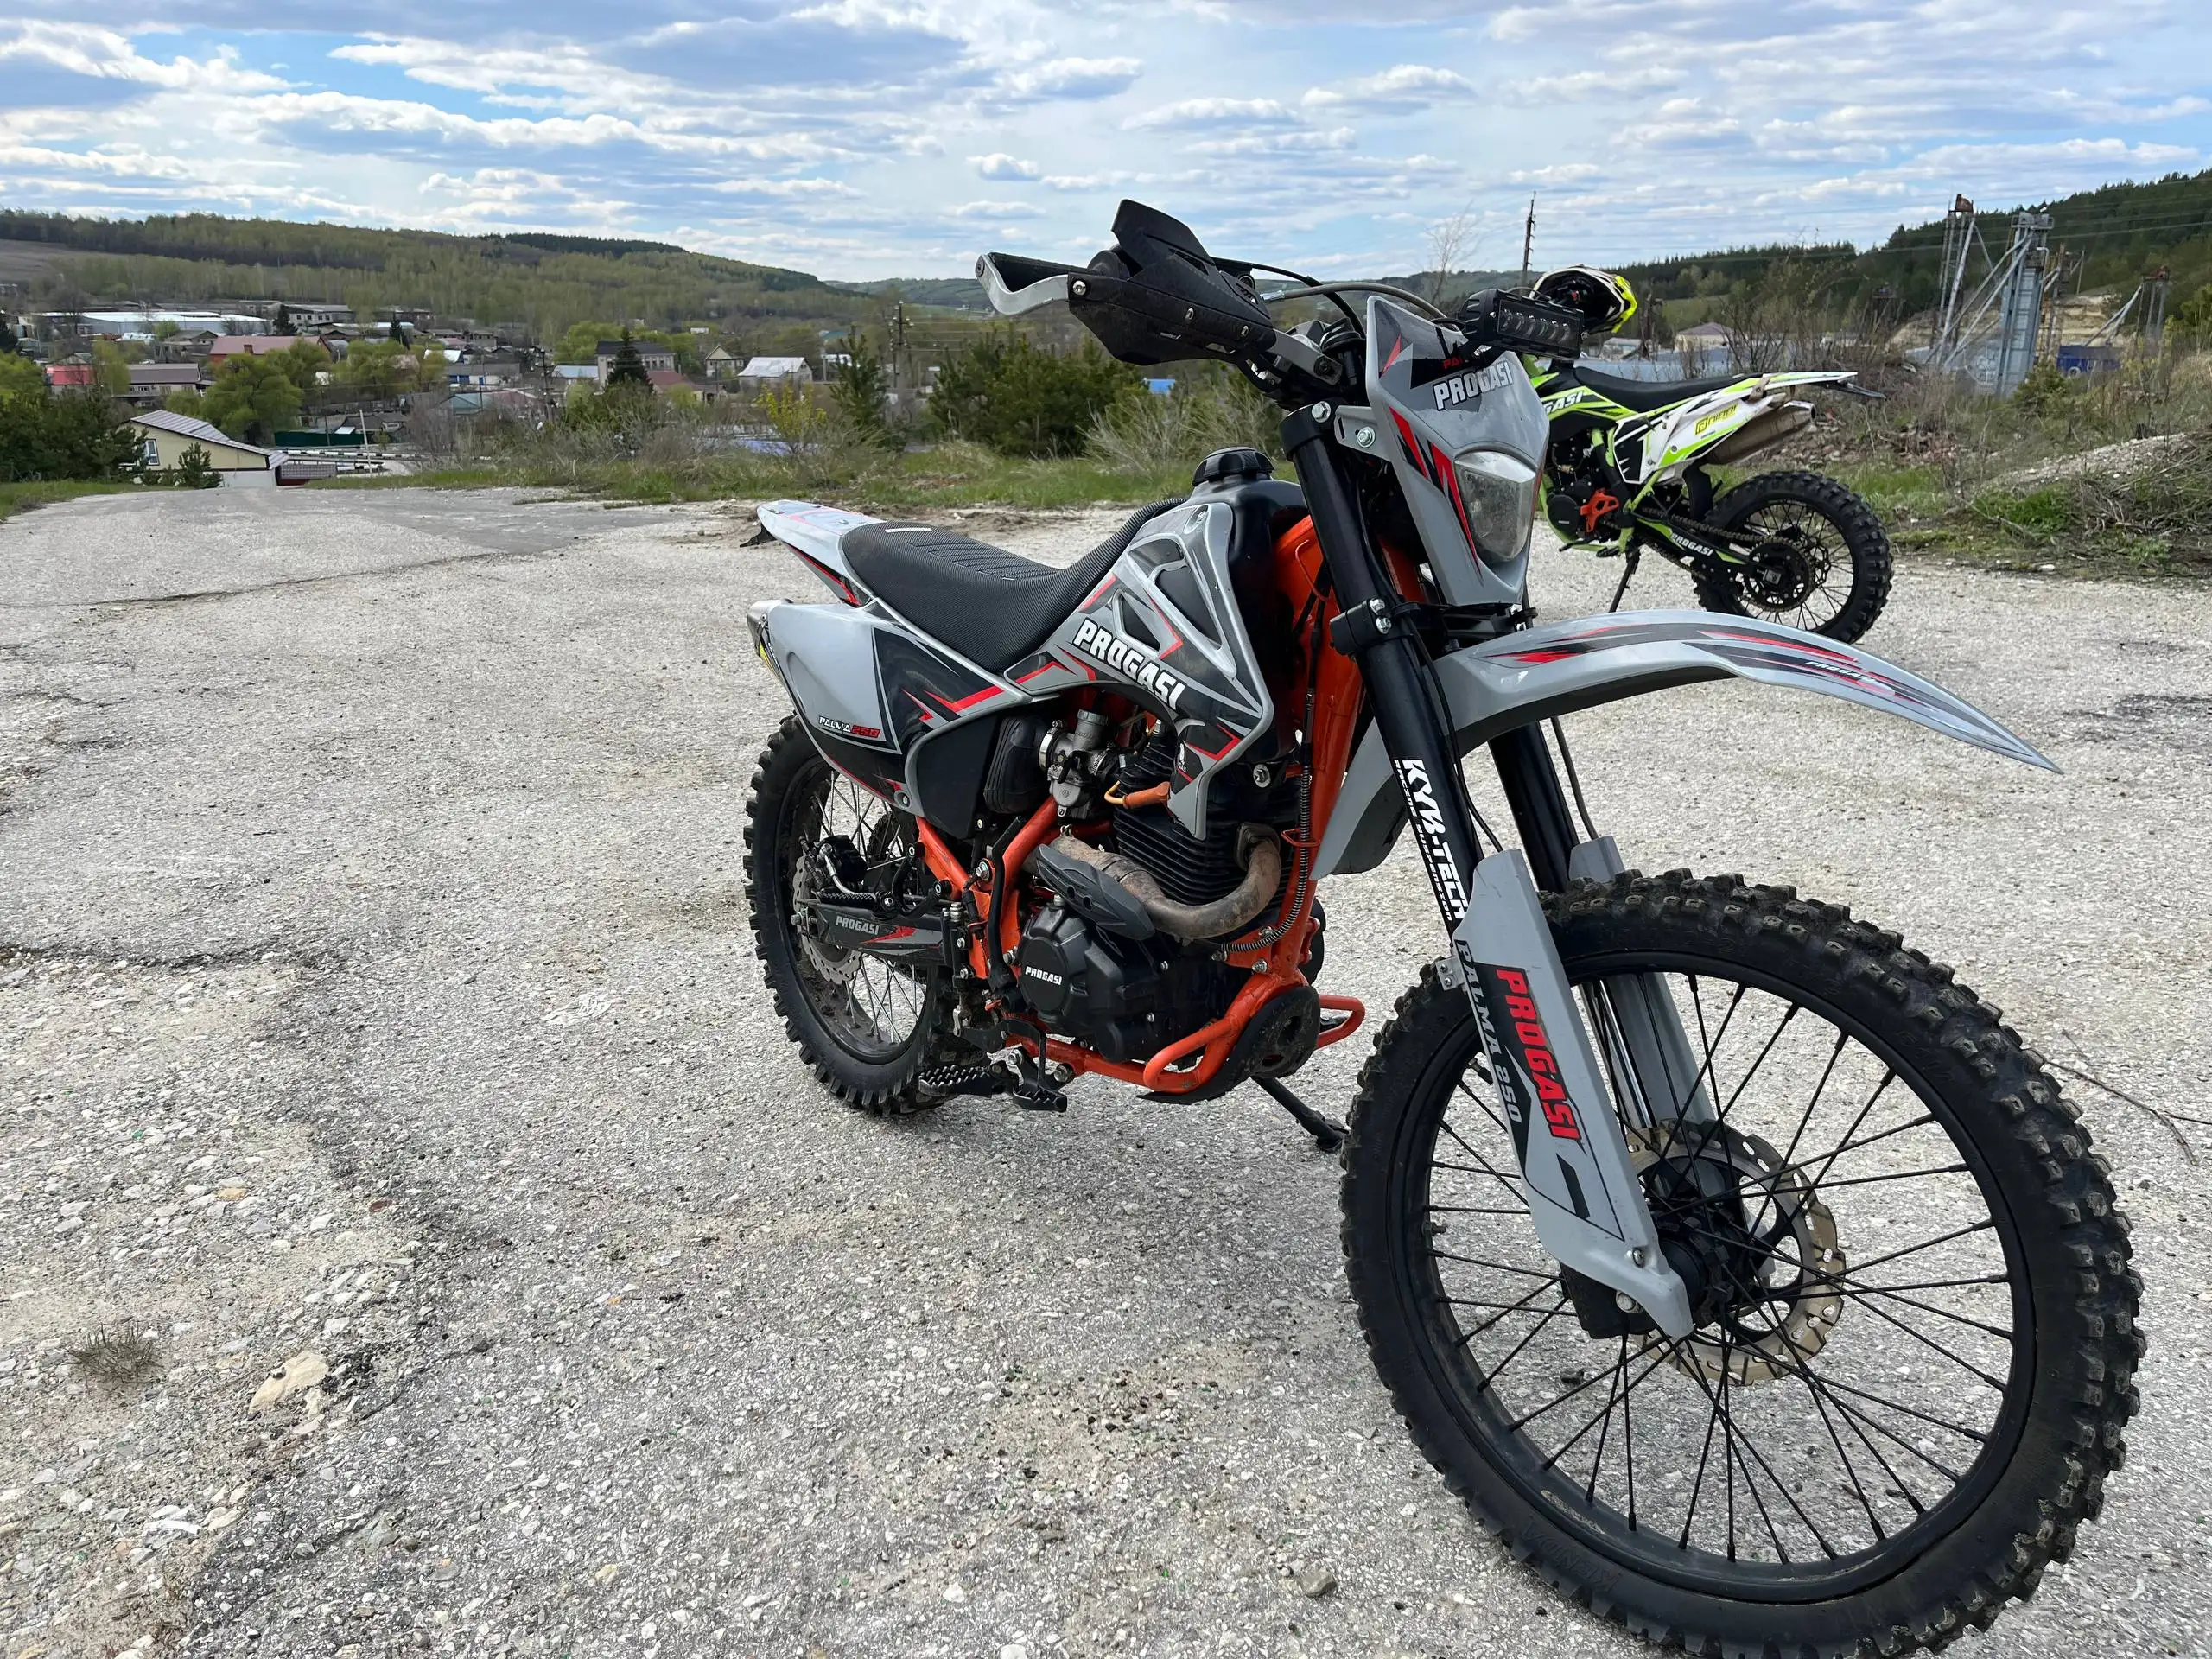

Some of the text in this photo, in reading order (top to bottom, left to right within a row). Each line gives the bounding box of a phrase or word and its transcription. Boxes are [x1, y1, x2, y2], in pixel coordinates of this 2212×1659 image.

[1433, 361, 1514, 411] PROGASI
[1543, 391, 1583, 414] GASI
[1670, 532, 1714, 556] PROGASI
[1072, 617, 1186, 710] PROGASI
[852, 725, 880, 738] 250
[835, 915, 880, 935] PROGASI
[1025, 965, 1063, 986] PROGASI
[1455, 940, 1522, 1123] PALMA 250
[1496, 969, 1581, 1140] PROGASI
[1519, 1521, 1623, 1592] KENDA
